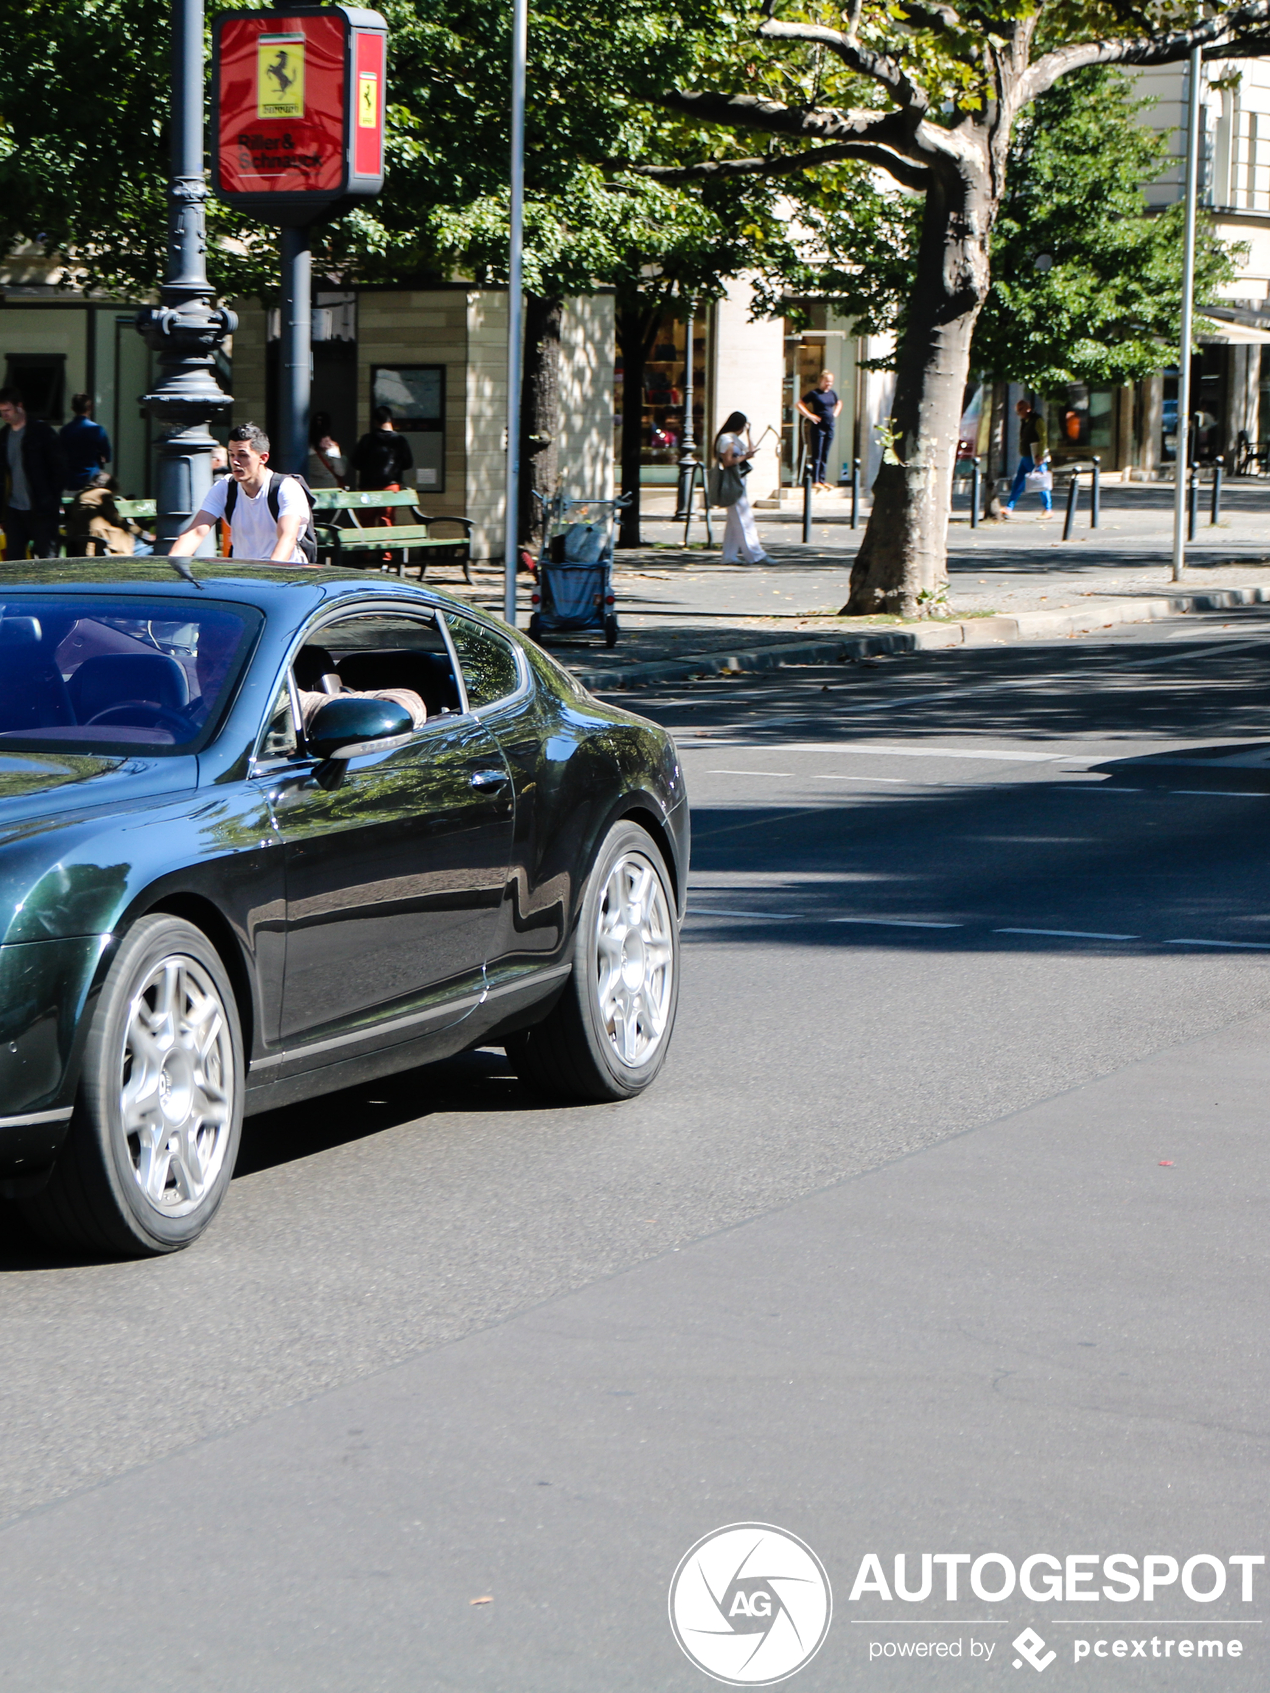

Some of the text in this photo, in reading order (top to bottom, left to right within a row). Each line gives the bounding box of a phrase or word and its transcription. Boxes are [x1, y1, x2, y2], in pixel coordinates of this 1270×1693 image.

[238, 133, 295, 150] Riller &
[238, 151, 322, 169] Schnauck
